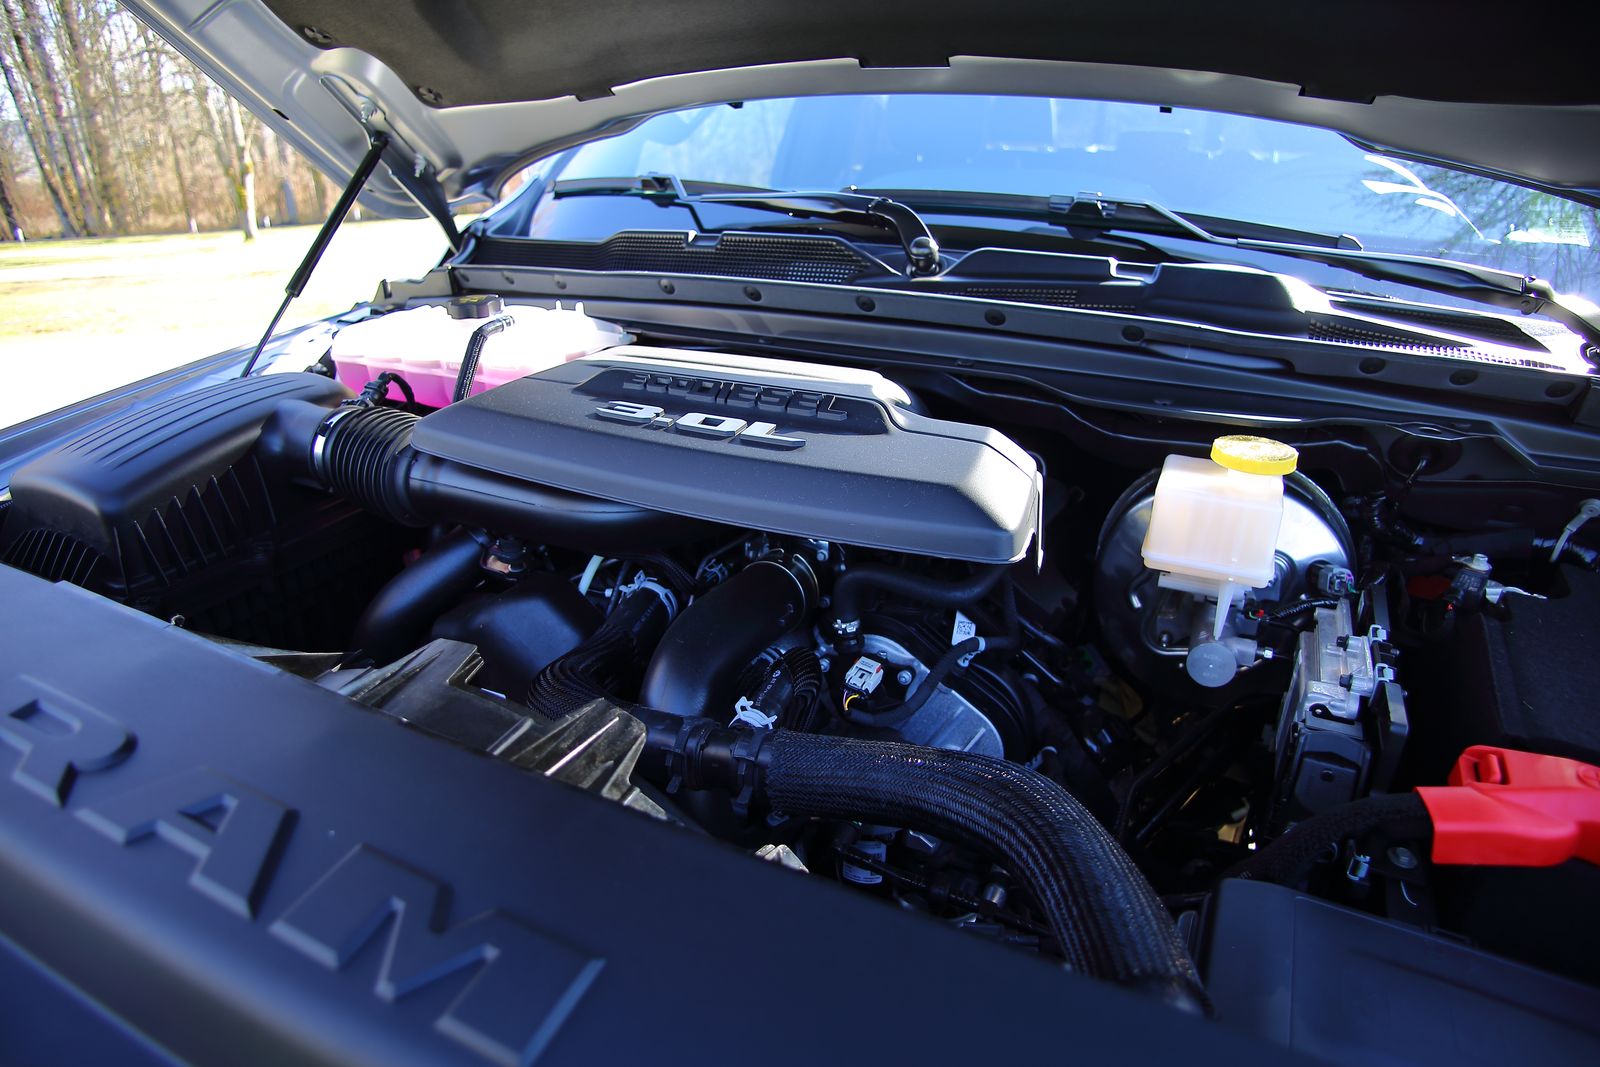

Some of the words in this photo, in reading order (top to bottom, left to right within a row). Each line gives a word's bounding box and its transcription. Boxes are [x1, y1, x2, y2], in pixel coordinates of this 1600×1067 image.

[622, 372, 848, 421] ECODIESEL
[596, 400, 806, 448] 3.0L
[0, 673, 606, 1067] RAM
